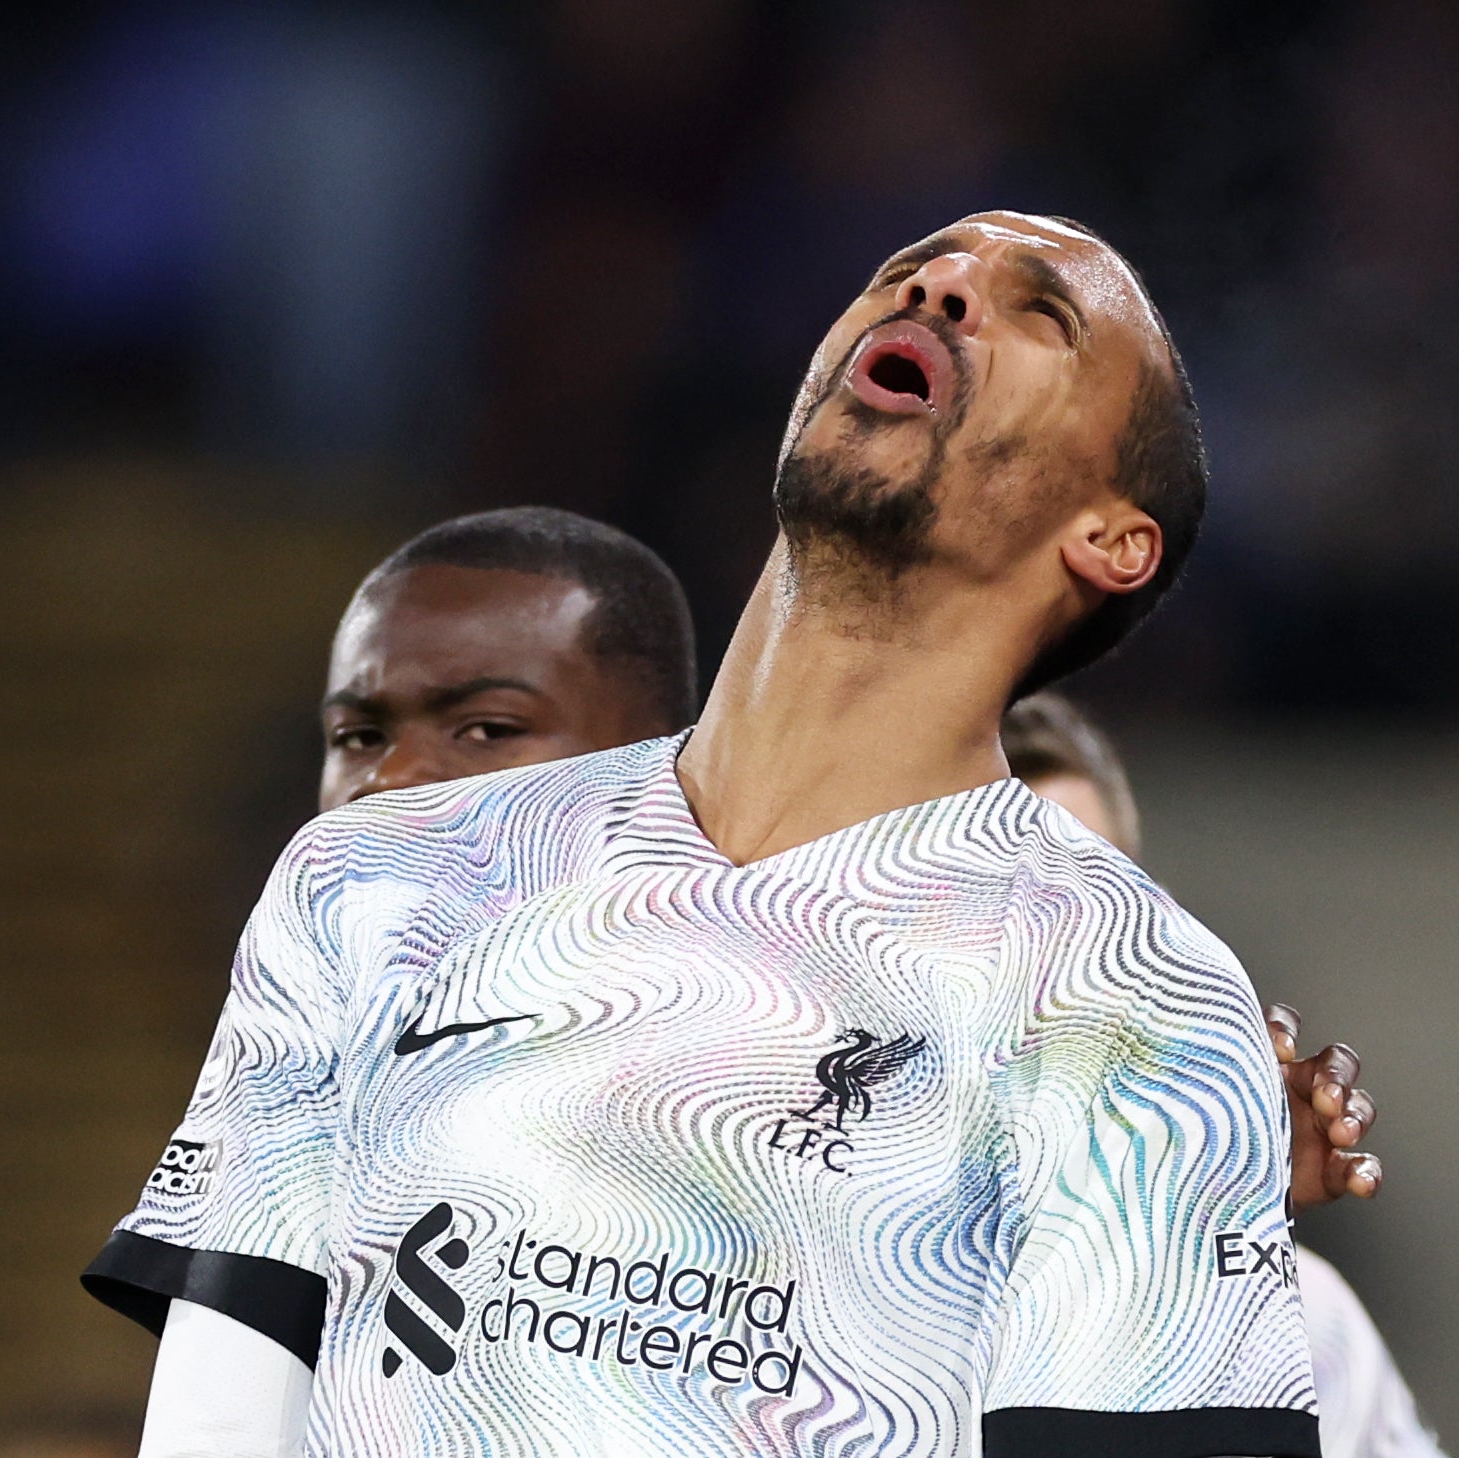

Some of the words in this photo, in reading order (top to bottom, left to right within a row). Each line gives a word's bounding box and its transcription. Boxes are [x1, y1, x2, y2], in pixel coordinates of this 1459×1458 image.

[145, 1166, 218, 1194] acism
[491, 1227, 798, 1334] standard
[1214, 1231, 1298, 1289] Exp
[480, 1286, 803, 1398] chartered
